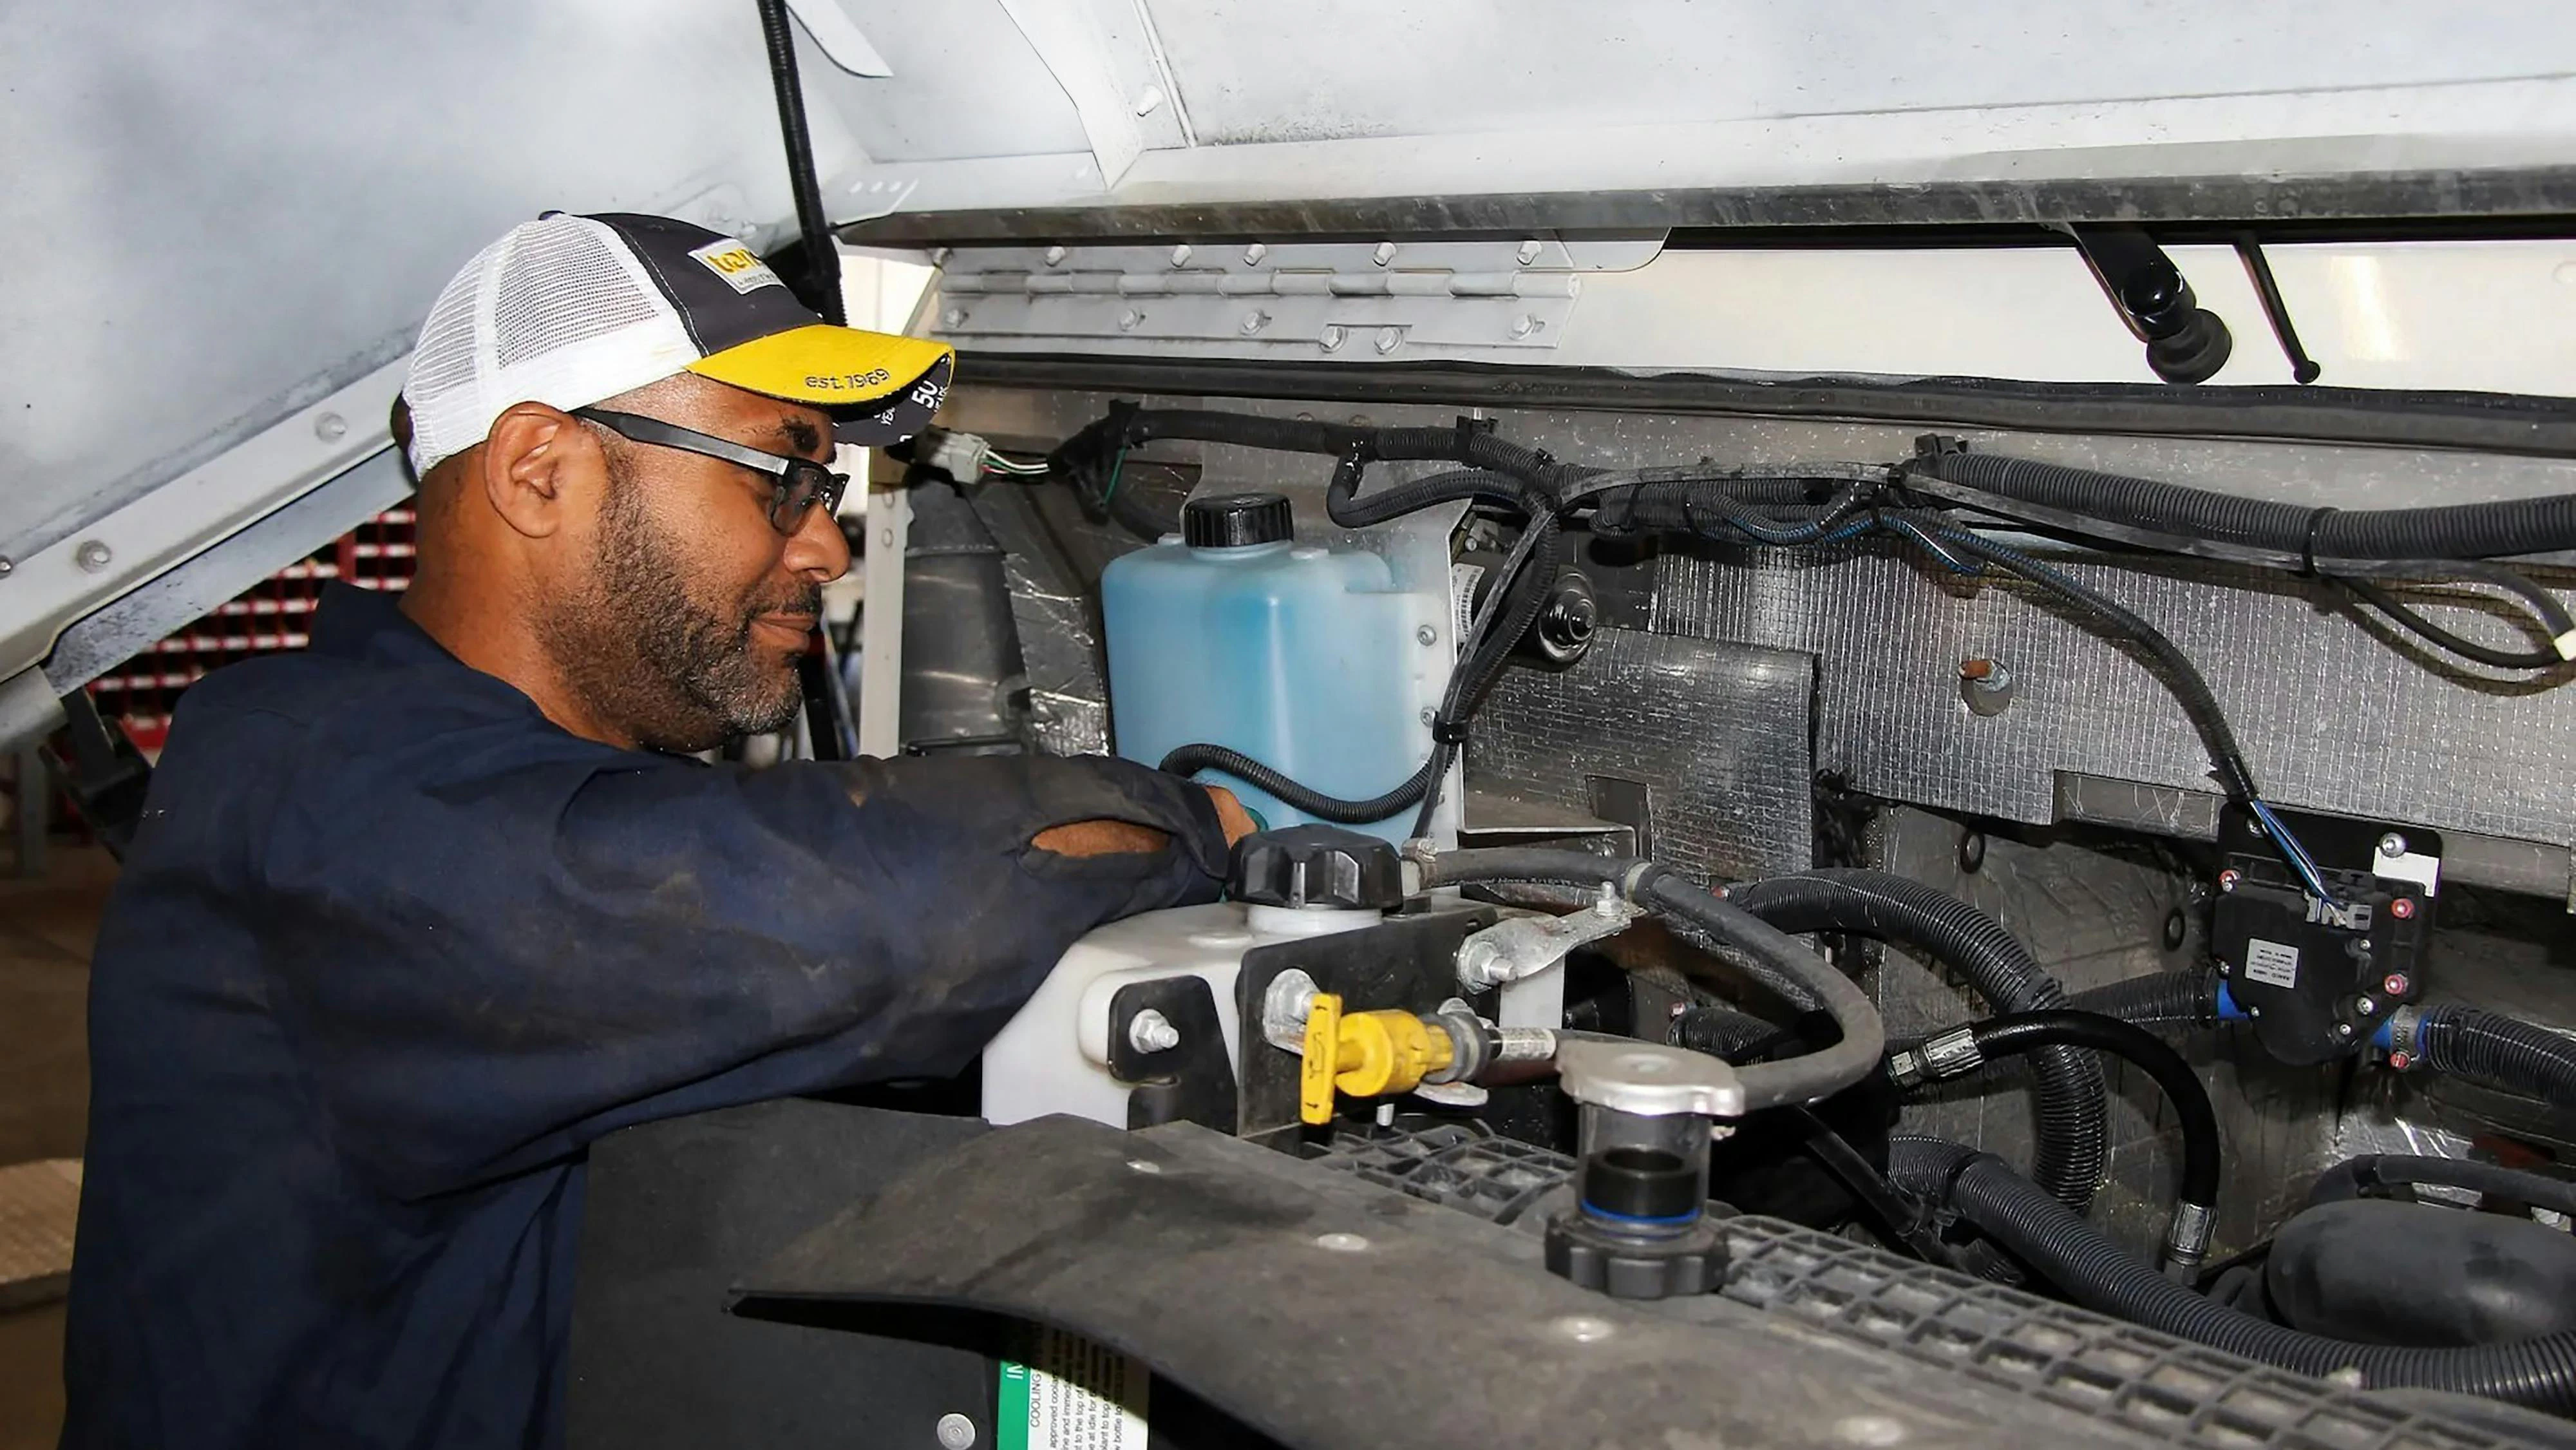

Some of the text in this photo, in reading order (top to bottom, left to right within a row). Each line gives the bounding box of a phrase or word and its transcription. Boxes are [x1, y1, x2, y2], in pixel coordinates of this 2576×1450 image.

[1030, 1373, 1042, 1428] COOLING
[1075, 1401, 1085, 1415] top
[1102, 1404, 1111, 1418] top
[1049, 1406, 1059, 1448] approved
[1113, 1418, 1122, 1443] bottle
